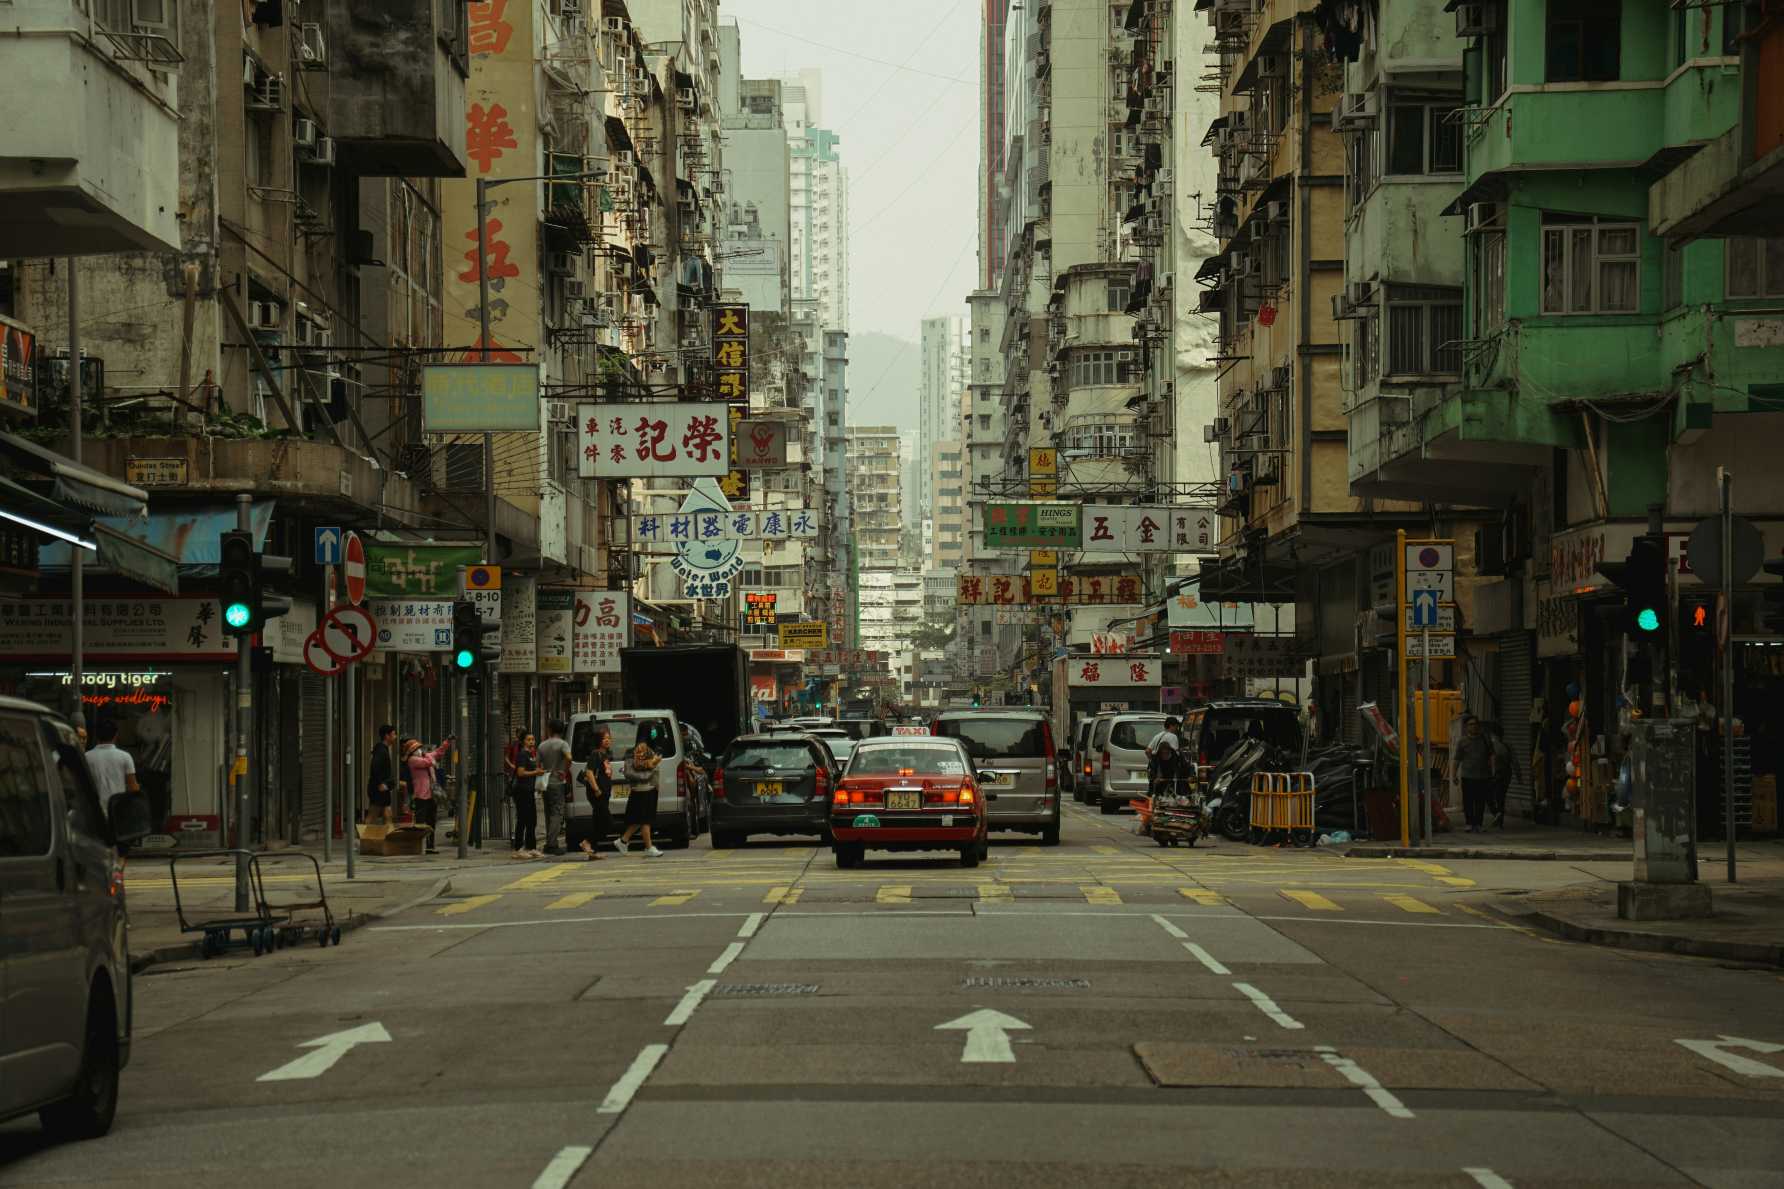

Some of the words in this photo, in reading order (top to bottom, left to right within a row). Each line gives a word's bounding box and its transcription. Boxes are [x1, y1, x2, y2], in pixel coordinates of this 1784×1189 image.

[458, 0, 523, 361] 昌華五
[634, 415, 723, 462] 榮記
[1040, 509, 1073, 517] HINGS
[670, 557, 705, 582] Water
[709, 556, 744, 582] World
[686, 583, 729, 597] 水世界
[62, 673, 116, 688] mody
[120, 672, 158, 685] tiger
[895, 727, 927, 735] TAXI
